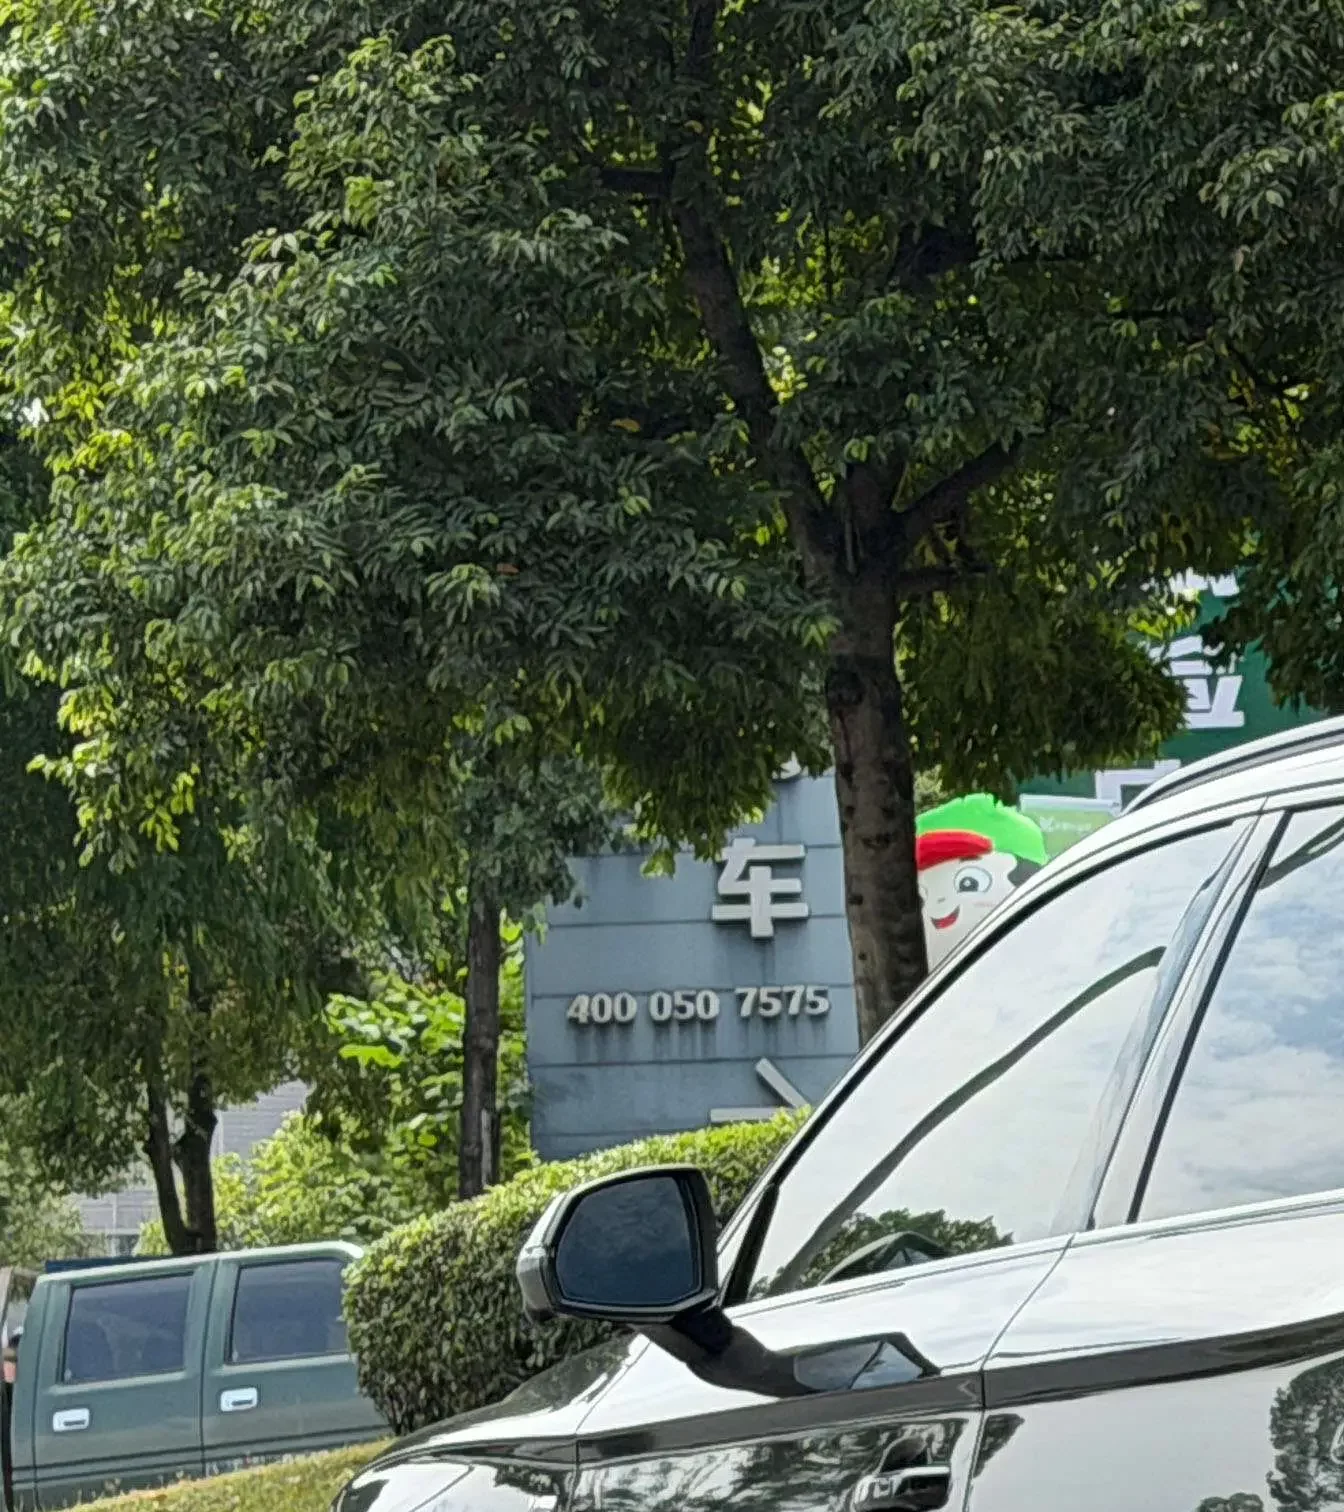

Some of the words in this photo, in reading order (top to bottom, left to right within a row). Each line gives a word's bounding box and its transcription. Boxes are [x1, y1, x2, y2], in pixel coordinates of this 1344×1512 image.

[711, 837, 810, 938] 车
[567, 993, 637, 1024] 400
[650, 989, 720, 1021] 050
[735, 985, 830, 1018] 7575
